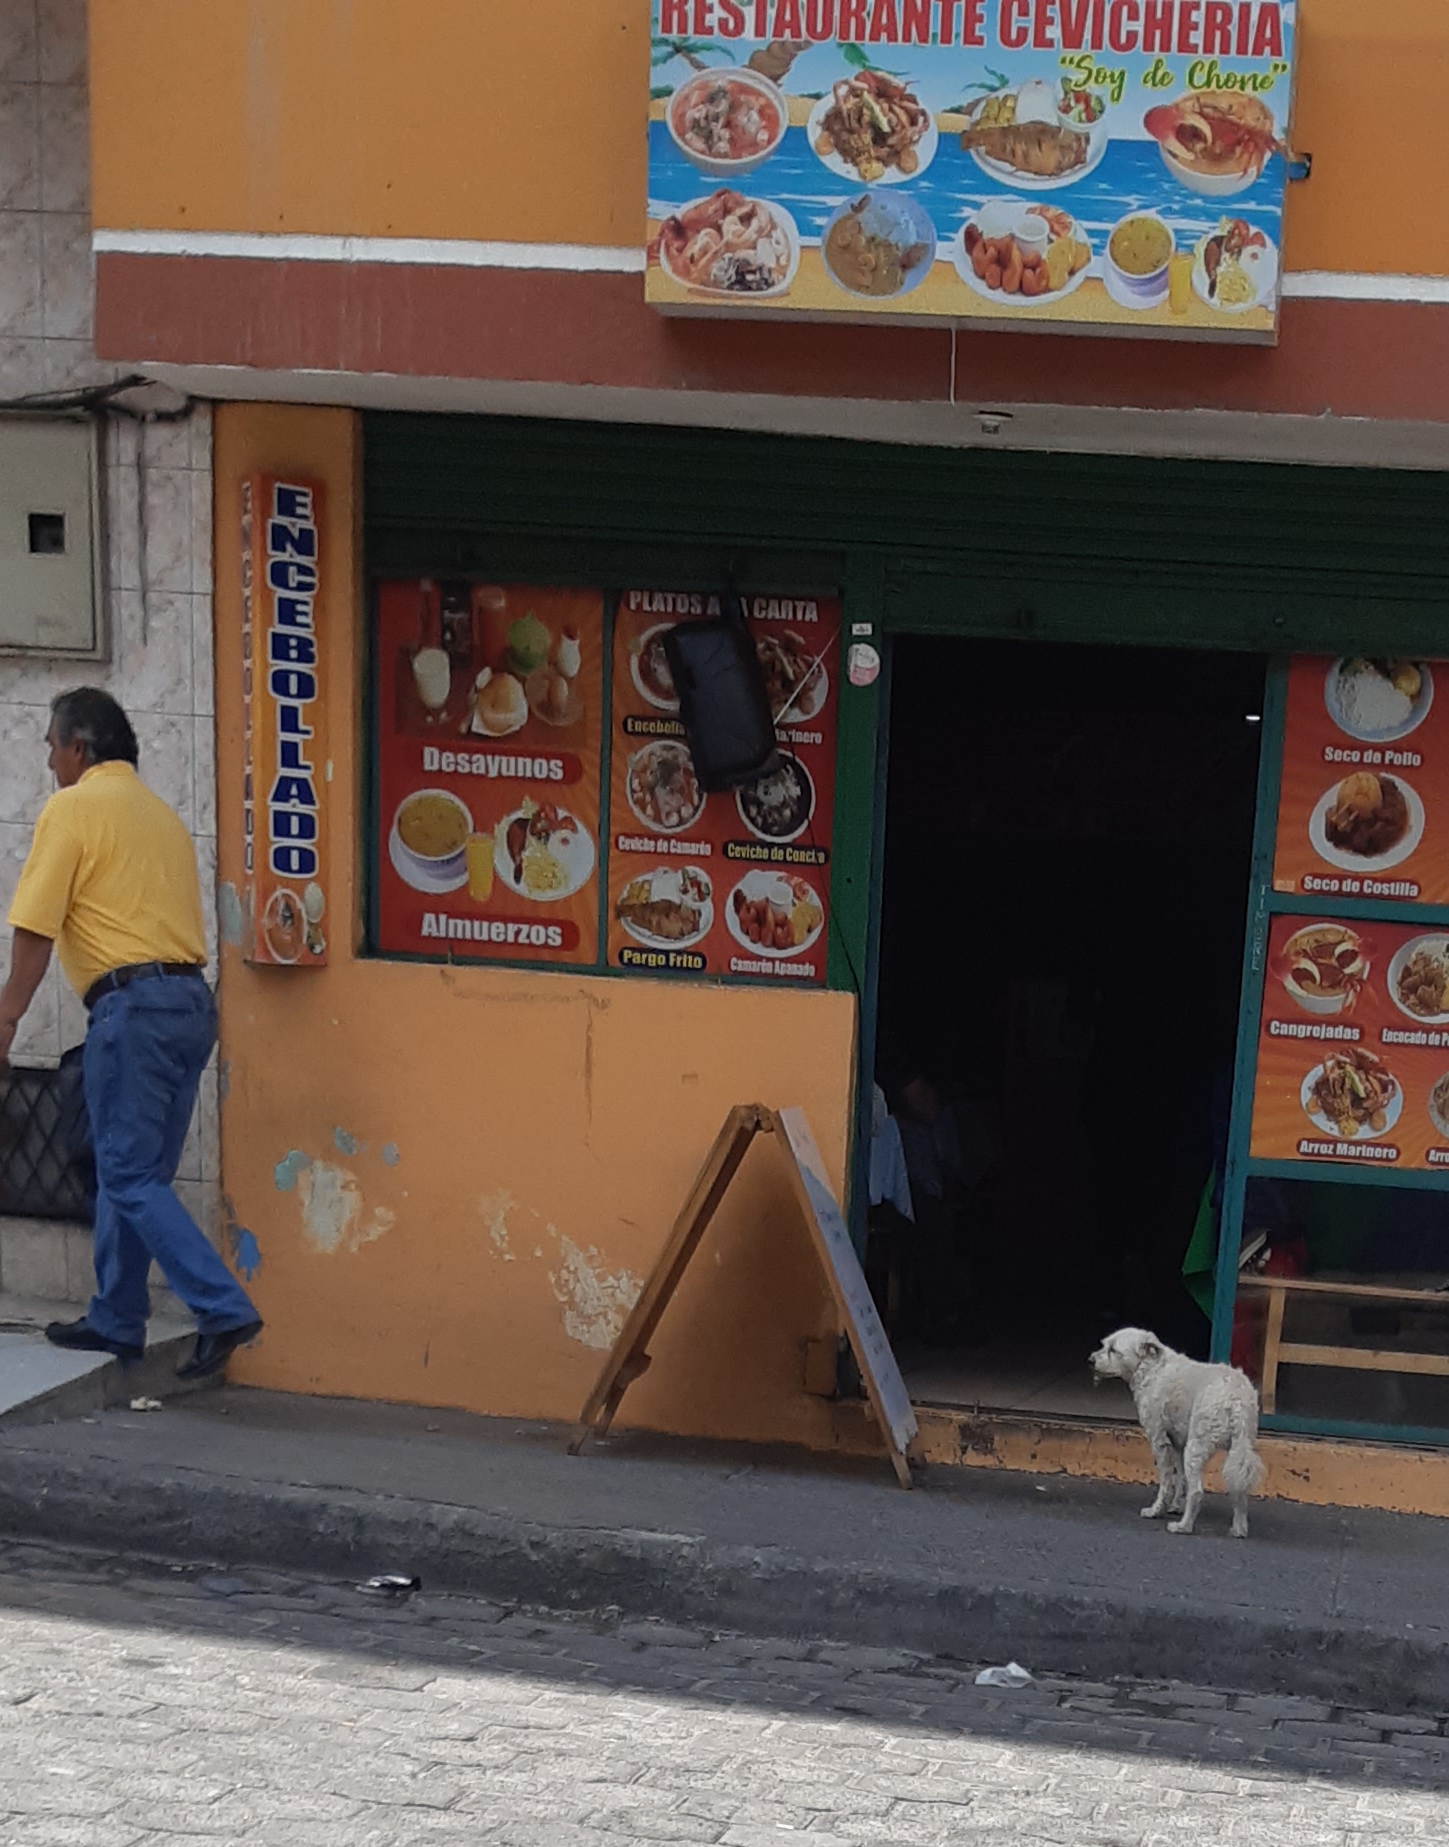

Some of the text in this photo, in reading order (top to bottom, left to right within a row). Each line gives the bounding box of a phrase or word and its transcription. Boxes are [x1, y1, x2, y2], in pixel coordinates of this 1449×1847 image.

[659, 0, 1284, 57] RESTAURANTE CEVICHERIA
[1142, 57, 1175, 88] de
[629, 590, 701, 615] PLATOS
[706, 595, 721, 617] A
[753, 598, 819, 623] CARTA
[267, 482, 319, 878] ENCEBOLLADO
[627, 718, 686, 736] Encebolla
[423, 746, 564, 780] Desayunos
[1324, 746, 1421, 766] Seco de Pollo
[618, 835, 655, 852] Ceviche
[656, 838, 668, 853] de
[727, 843, 769, 860] Ceviche
[770, 845, 783, 861] de
[1304, 876, 1339, 892] Seco
[1342, 877, 1360, 893] de
[1363, 879, 1418, 897] Costilla
[421, 913, 562, 946] Almuerzos
[622, 949, 703, 969] Pargo Frito
[774, 960, 816, 977] Apanado
[1270, 1020, 1360, 1040] Cangrejadas
[1382, 1028, 1427, 1045] Encocado
[1428, 1031, 1440, 1046] de
[1299, 1140, 1397, 1159] Arroz Marinero
